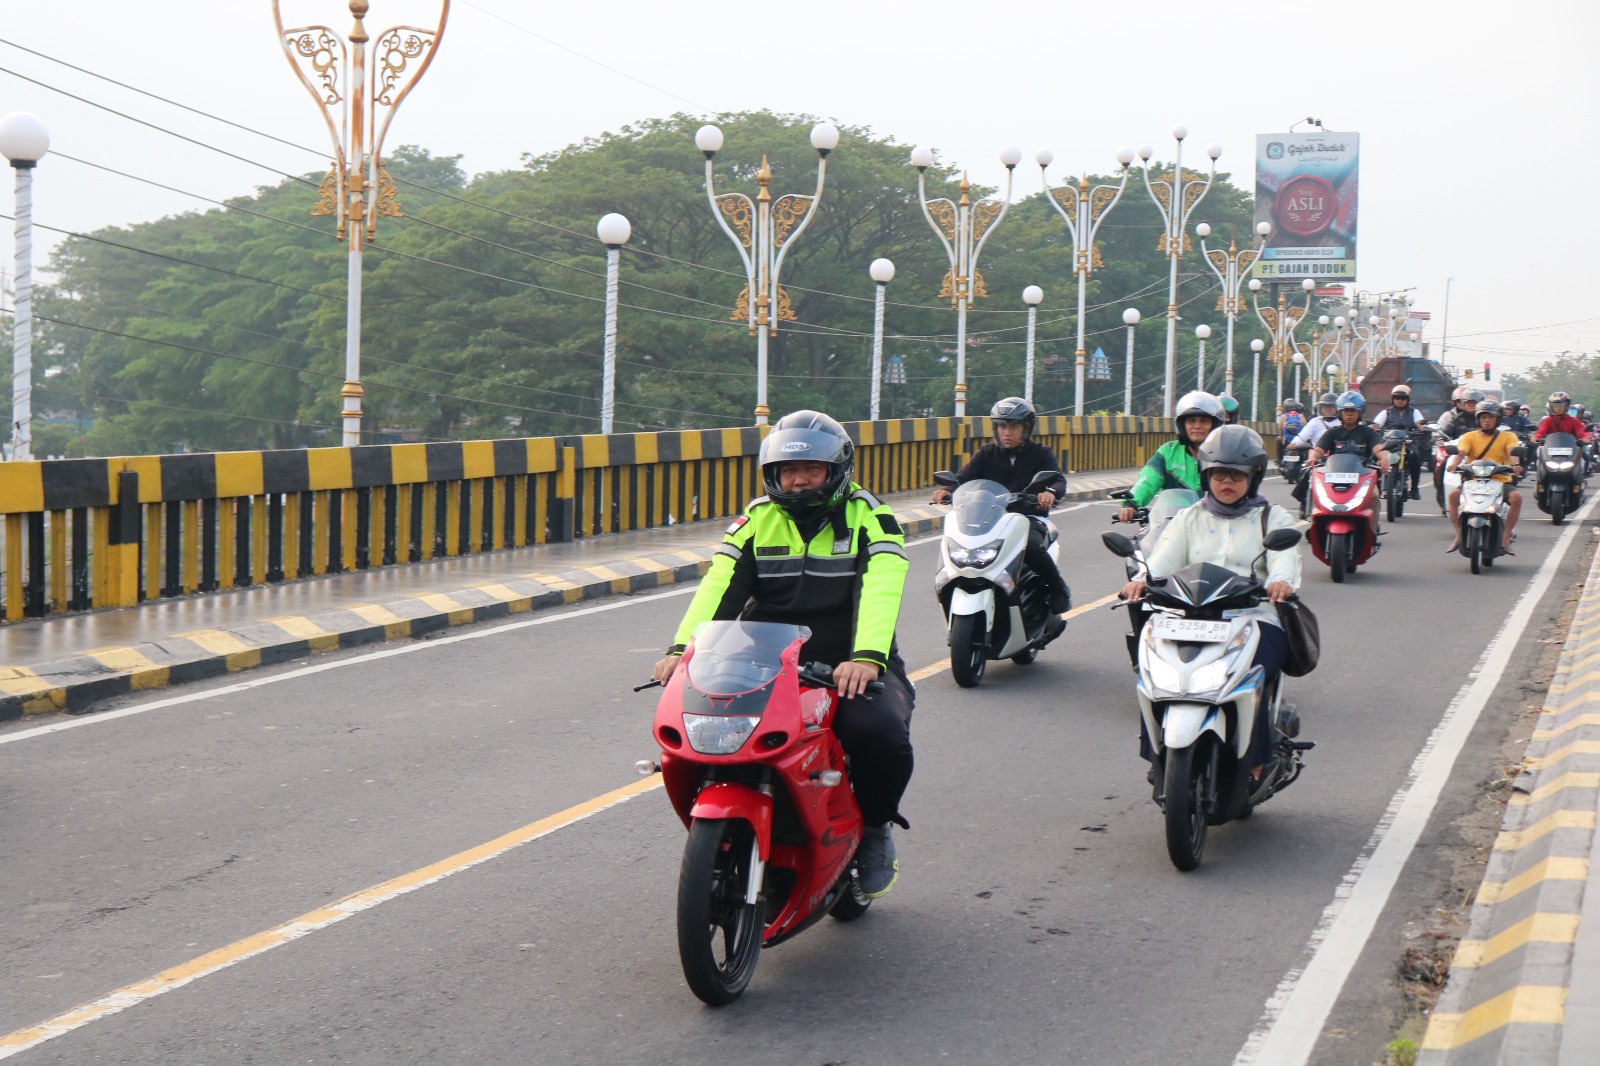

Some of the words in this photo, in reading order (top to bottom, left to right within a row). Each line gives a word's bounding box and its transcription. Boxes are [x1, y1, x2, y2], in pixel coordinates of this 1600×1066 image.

[1288, 144, 1315, 156] Gajah
[1317, 143, 1345, 152] Duduk
[1287, 197, 1324, 210] ASLI
[1262, 264, 1275, 274] PT.
[1279, 264, 1309, 274] GAJAH
[1312, 263, 1347, 273] DUDUK
[1157, 620, 1172, 629] AE
[1179, 622, 1207, 631] 5258
[1212, 623, 1228, 632] BR
